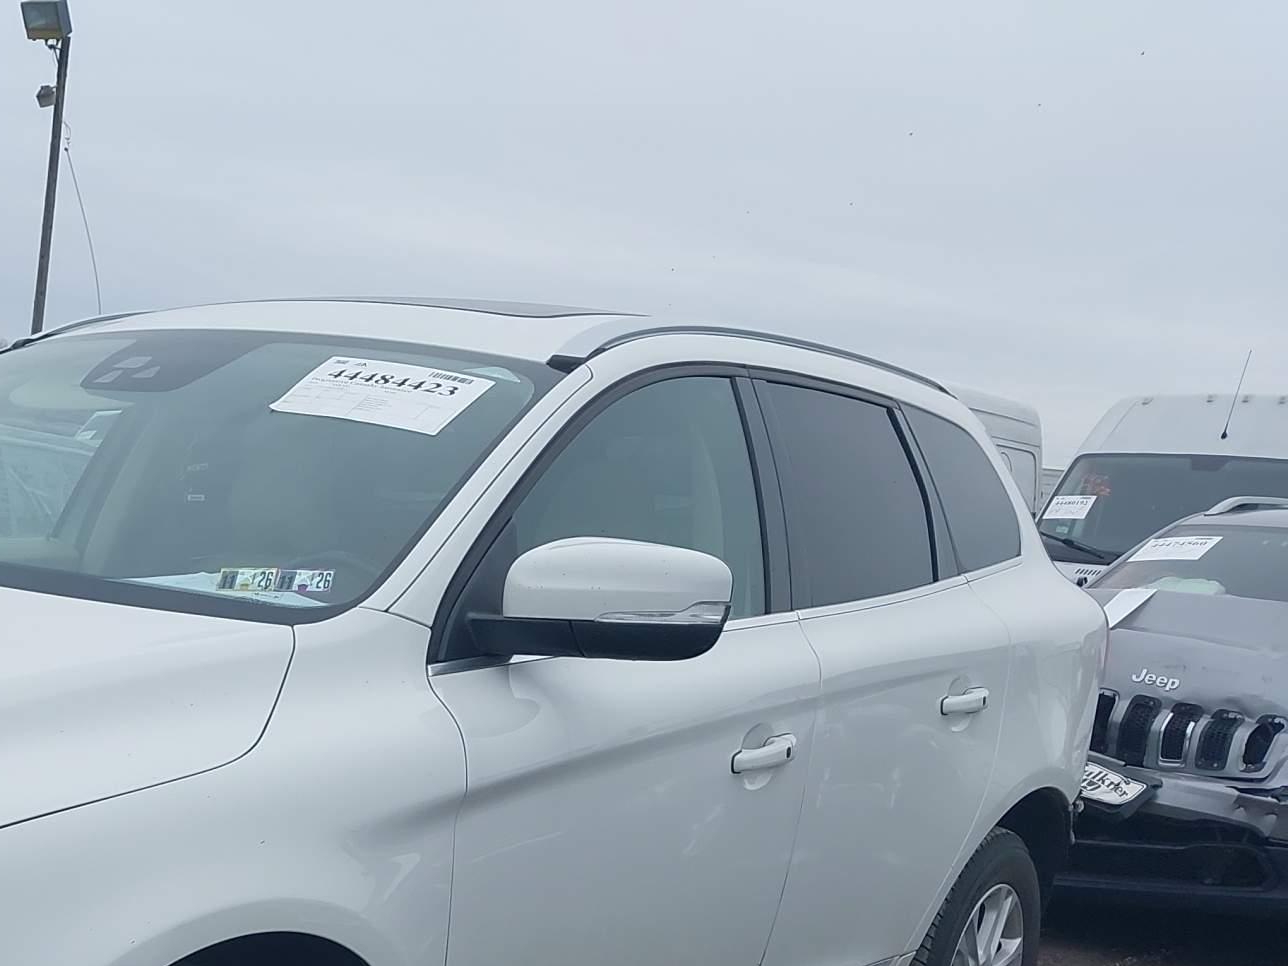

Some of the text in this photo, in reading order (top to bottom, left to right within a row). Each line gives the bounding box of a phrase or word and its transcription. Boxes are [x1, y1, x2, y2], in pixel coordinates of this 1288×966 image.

[327, 368, 459, 397] 44484423
[257, 571, 274, 590] 26
[315, 572, 332, 590] 26
[1131, 668, 1180, 691] Jeep
